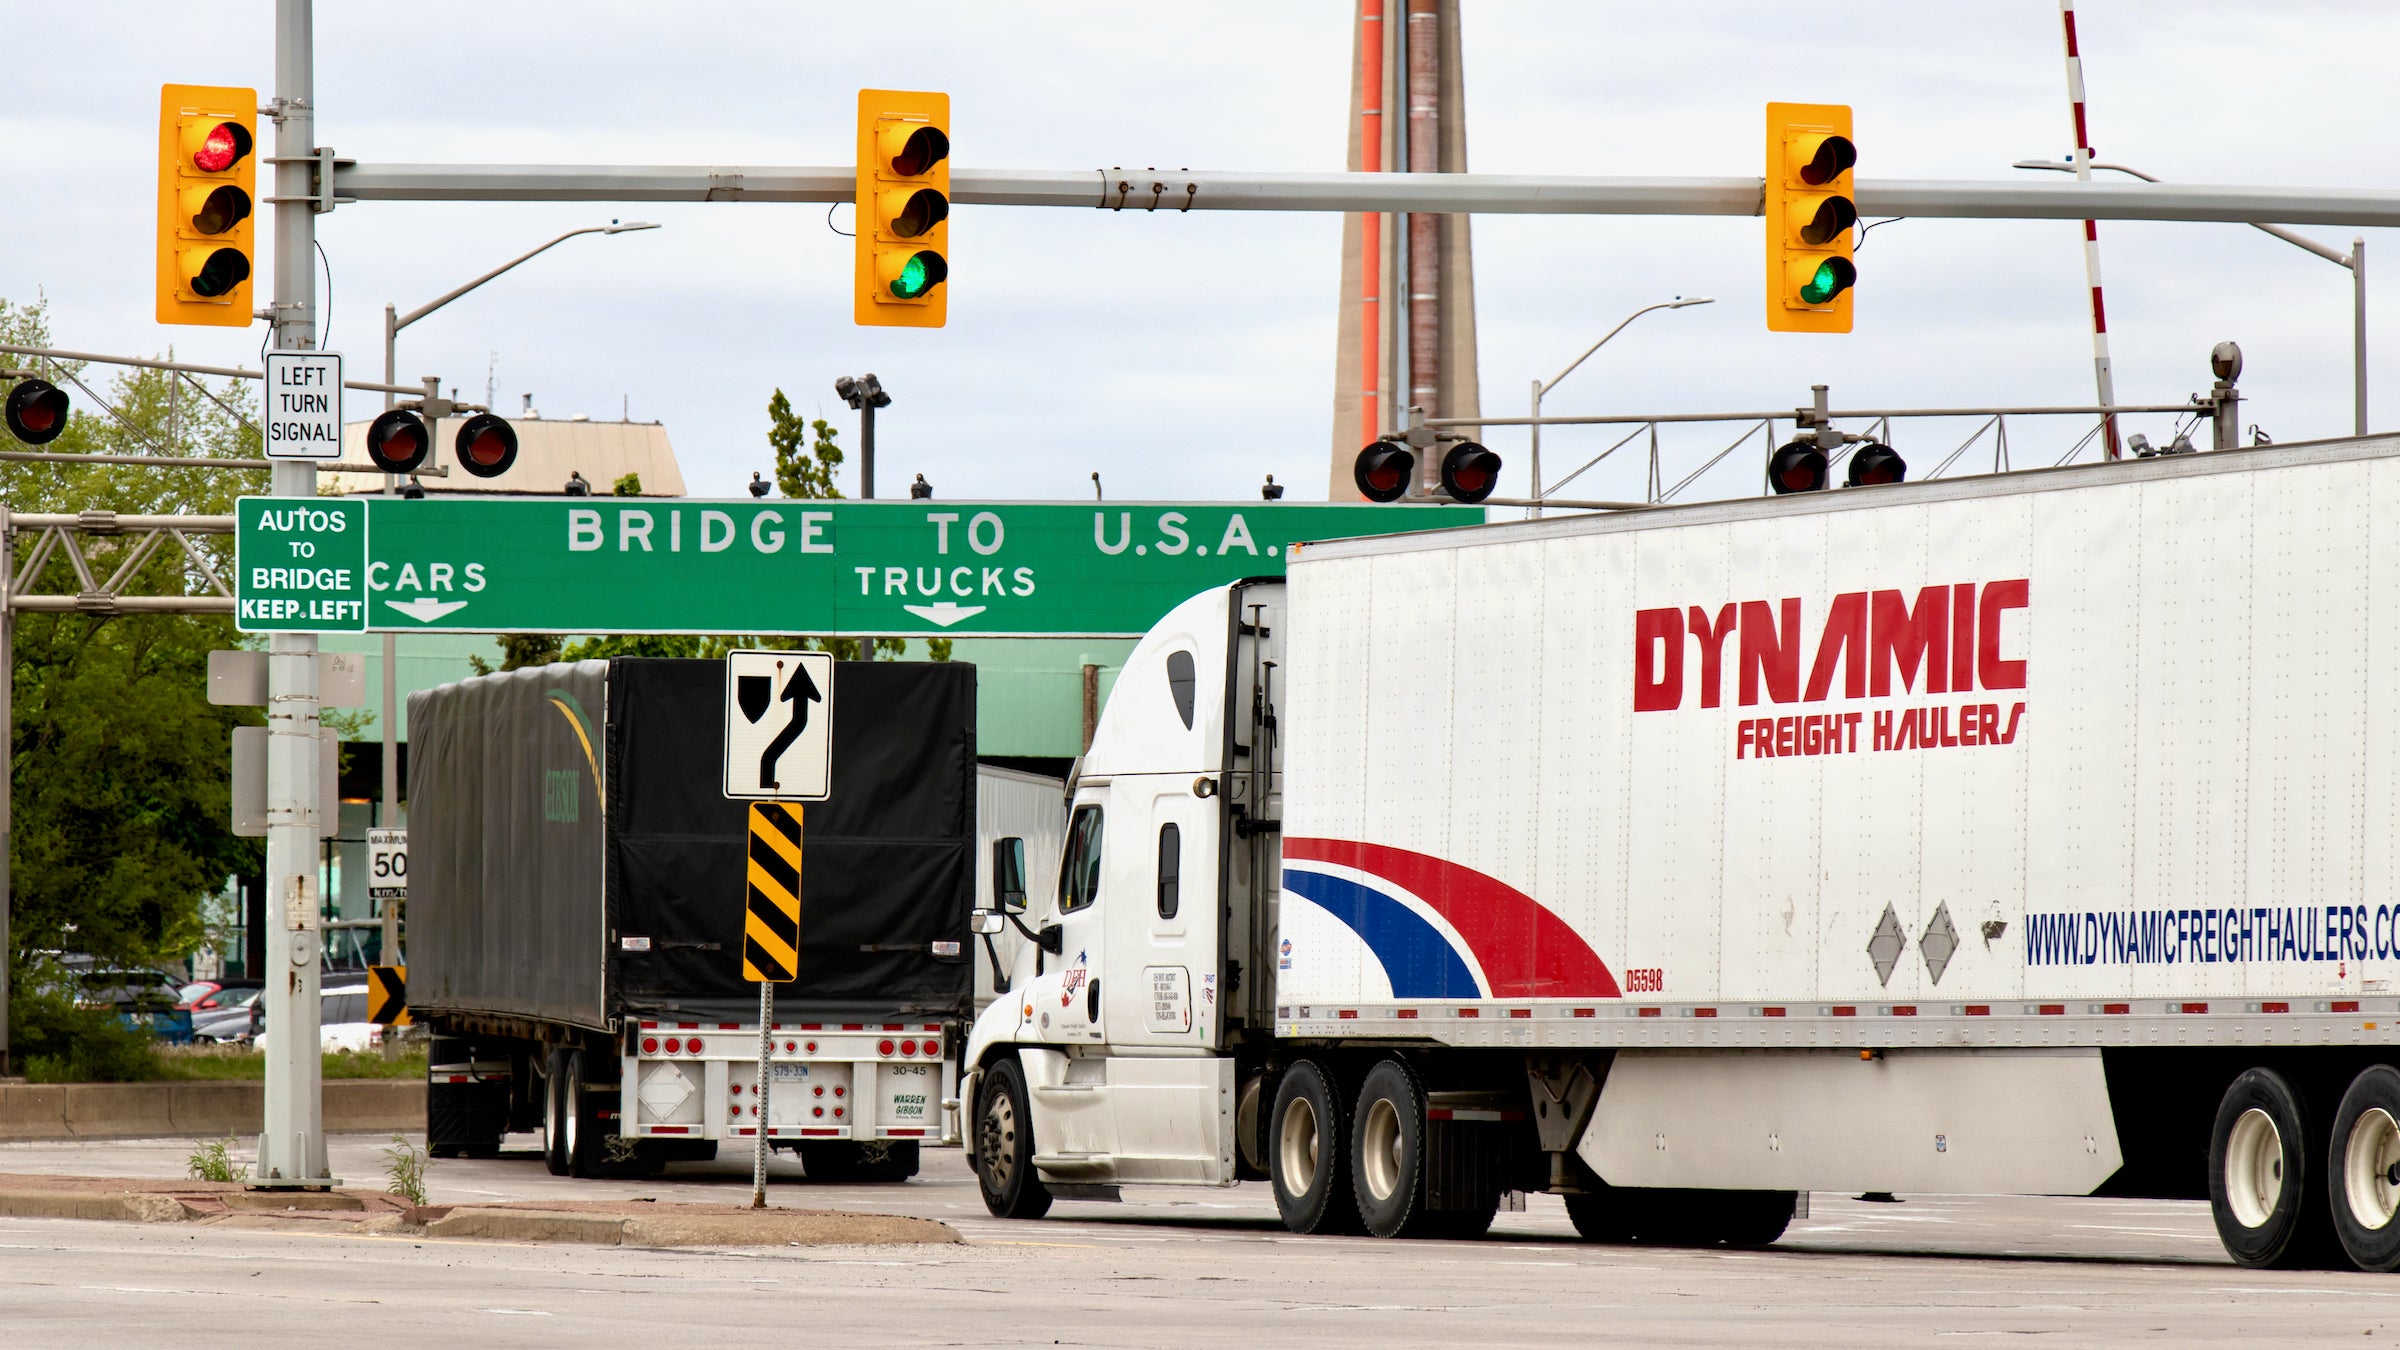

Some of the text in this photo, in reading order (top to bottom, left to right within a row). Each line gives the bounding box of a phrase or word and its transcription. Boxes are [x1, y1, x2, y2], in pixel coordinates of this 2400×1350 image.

[281, 367, 326, 386] LEFT
[281, 393, 328, 413] TURN
[271, 422, 337, 442] SIGNAL
[258, 508, 346, 533] AUTOS
[568, 509, 1278, 557] BRIDGE TO U.S.A.
[288, 541, 316, 559] TO
[252, 567, 351, 591] BRIDGE
[368, 562, 486, 593] CARS
[854, 566, 1036, 597] TRUCKS
[241, 599, 363, 621] KEEP LEFT
[1633, 578, 2029, 713] DYNAMIC
[1737, 702, 2027, 760] FREIGHT HAULERS
[374, 851, 407, 878] 50
[1062, 969, 1087, 988] DFH
[1626, 968, 1663, 993] D5598
[893, 1066, 927, 1076] 30-45
[894, 1094, 927, 1104] WARREN
[896, 1105, 924, 1115] GIBSON
